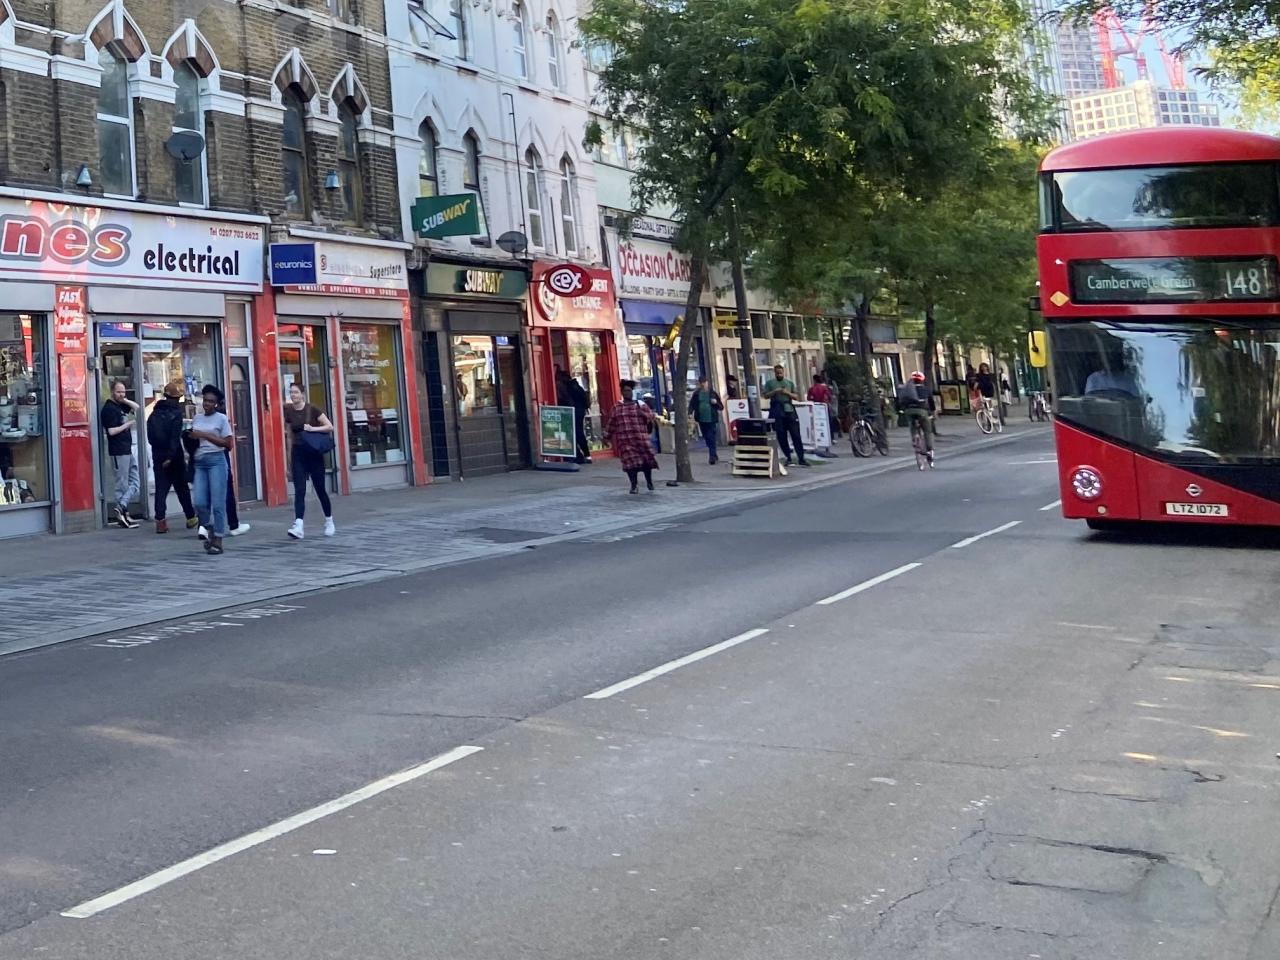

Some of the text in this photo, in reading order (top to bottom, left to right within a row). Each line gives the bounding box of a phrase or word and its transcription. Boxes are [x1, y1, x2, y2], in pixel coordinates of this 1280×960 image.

[421, 199, 471, 232] SUBWAY
[143, 243, 240, 276] electrical
[278, 259, 313, 269] euronics
[618, 245, 667, 279] OCCASION
[370, 263, 401, 280] Superstore
[464, 270, 504, 293] SUBWAY
[1160, 276, 1196, 288] Green
[1226, 268, 1261, 295] 148
[1172, 503, 1221, 515] LTZ 1072
